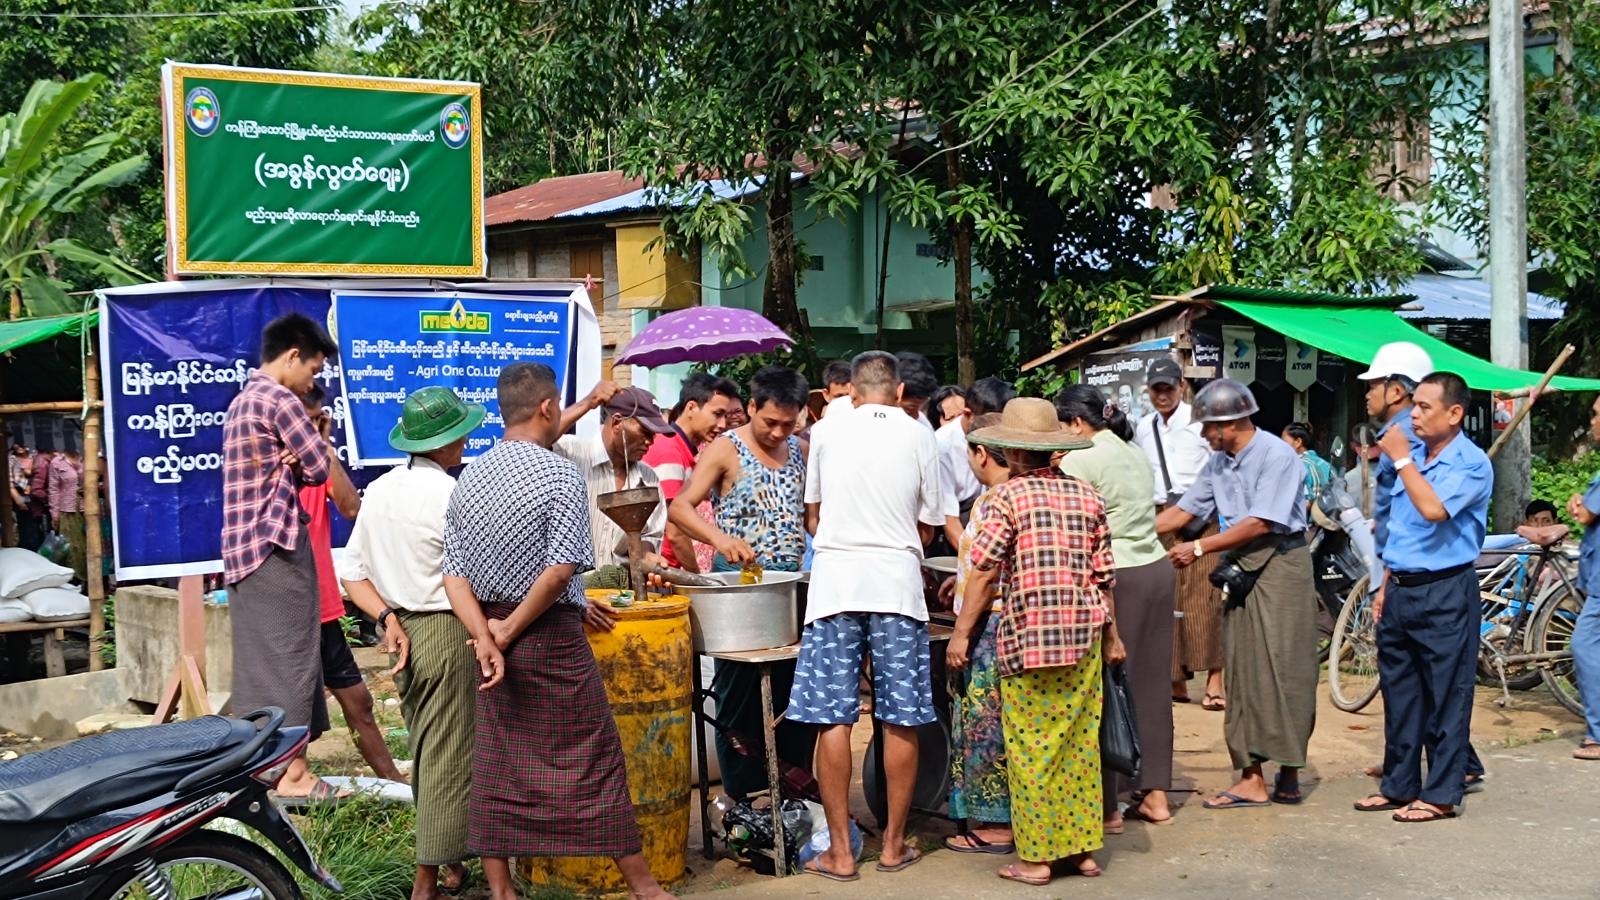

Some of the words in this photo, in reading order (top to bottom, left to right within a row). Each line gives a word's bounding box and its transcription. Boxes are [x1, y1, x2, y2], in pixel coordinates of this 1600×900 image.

[1229, 361, 1250, 370] ATOM
[1292, 362, 1312, 371] ATOM
[416, 365, 438, 379] Agri
[442, 364, 464, 376] One
